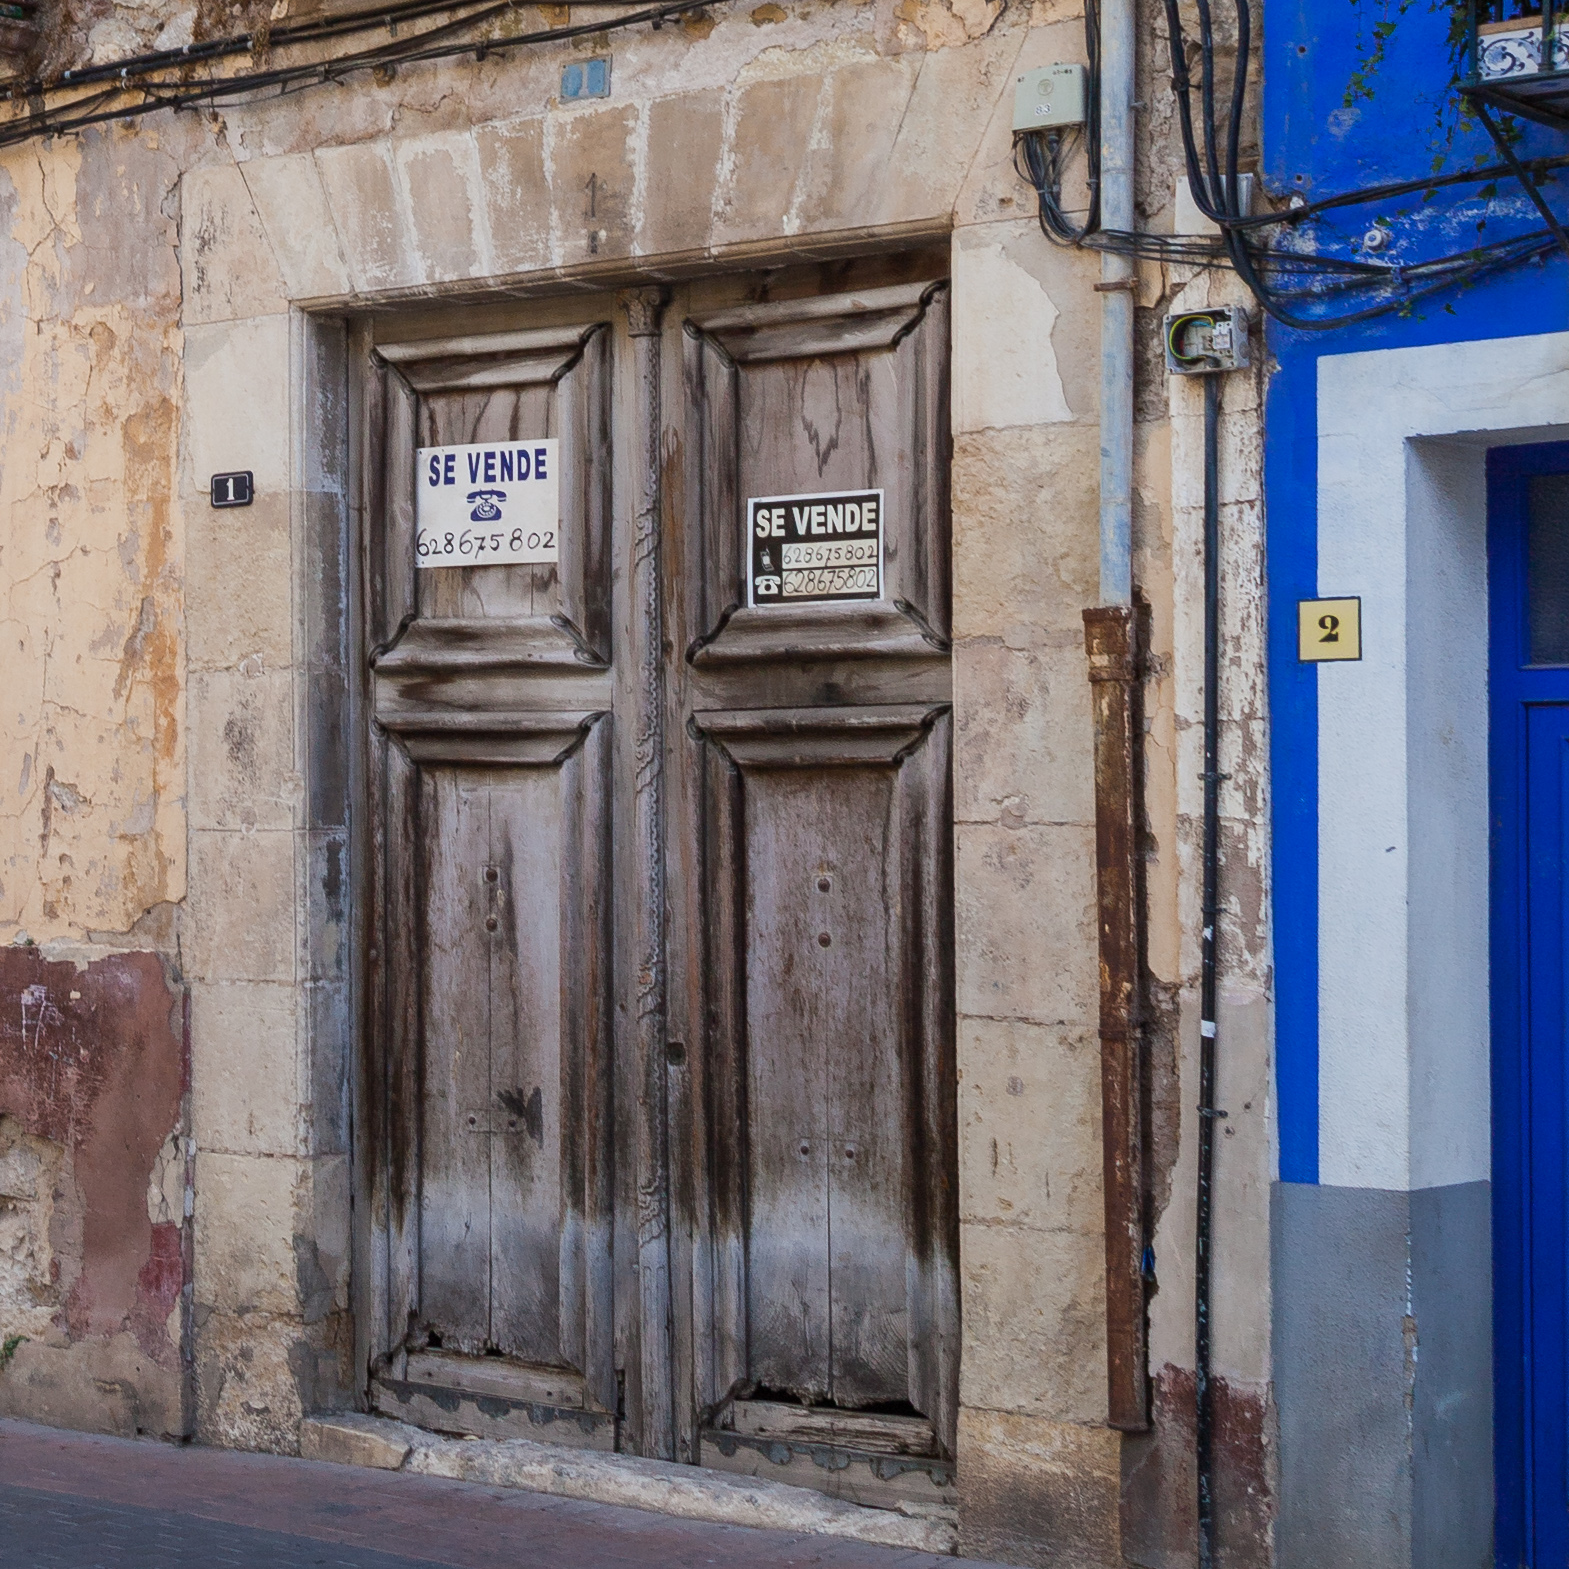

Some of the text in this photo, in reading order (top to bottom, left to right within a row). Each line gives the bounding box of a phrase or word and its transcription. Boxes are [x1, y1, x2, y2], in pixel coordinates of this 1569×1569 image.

[428, 448, 547, 487] SE VENDE
[226, 477, 235, 501] 1
[755, 501, 877, 538] SE VENDE
[783, 544, 877, 567] 628675802
[783, 568, 876, 594] 628675802
[1318, 614, 1340, 643] 2
